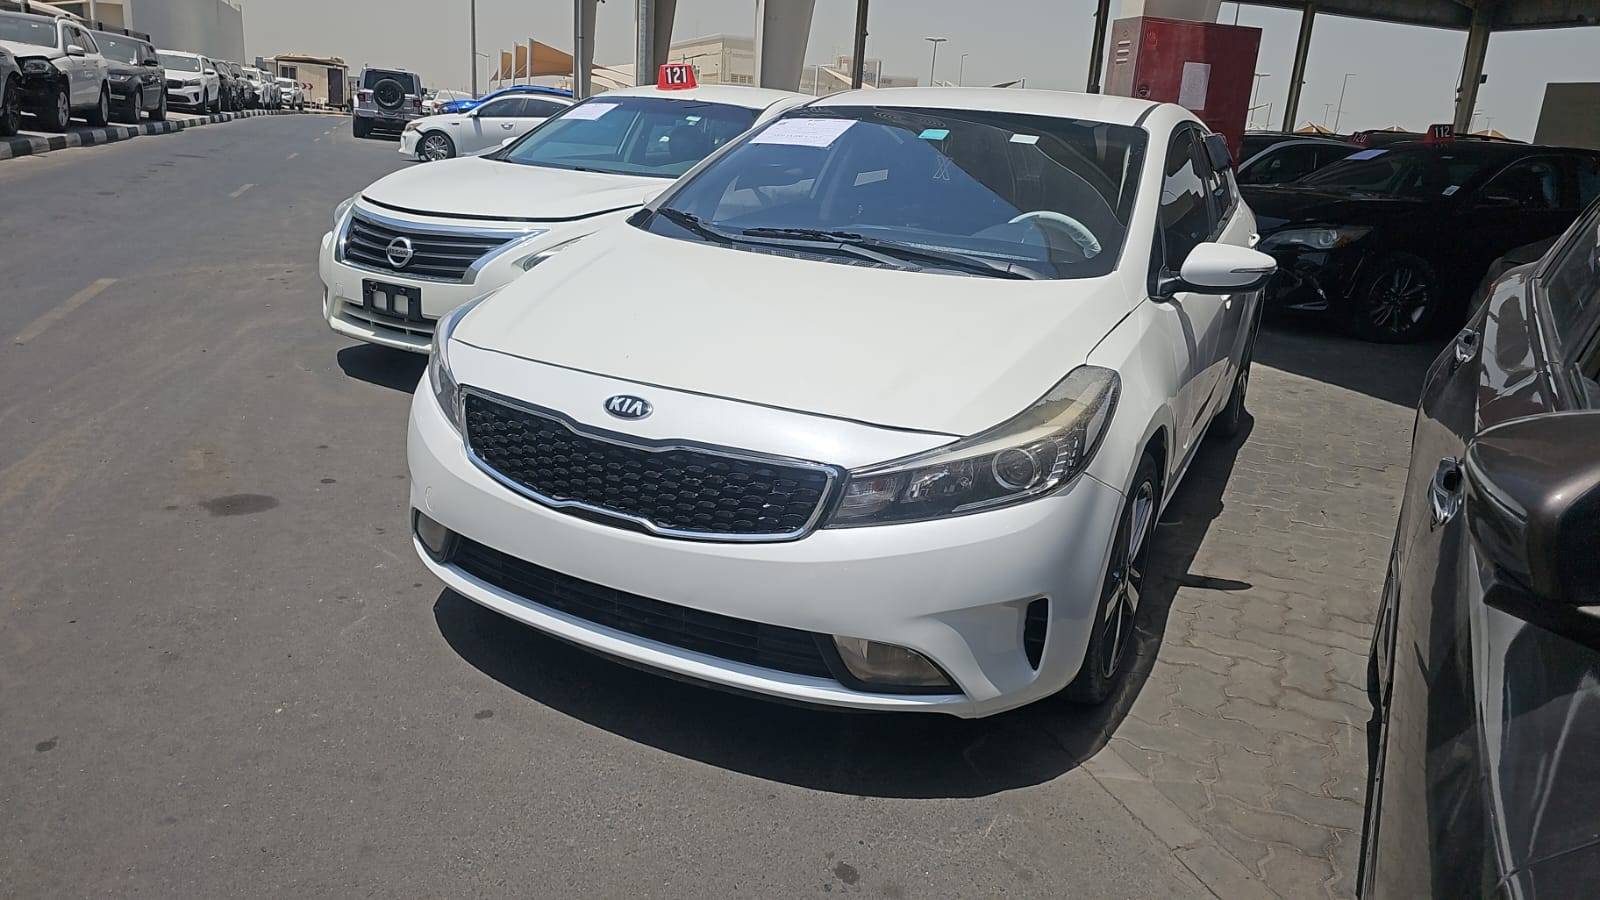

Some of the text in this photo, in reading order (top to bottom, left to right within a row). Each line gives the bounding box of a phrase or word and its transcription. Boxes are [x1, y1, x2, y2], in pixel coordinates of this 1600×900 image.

[666, 66, 687, 84] 121
[1435, 125, 1451, 138] 112
[608, 396, 643, 415] KIA
